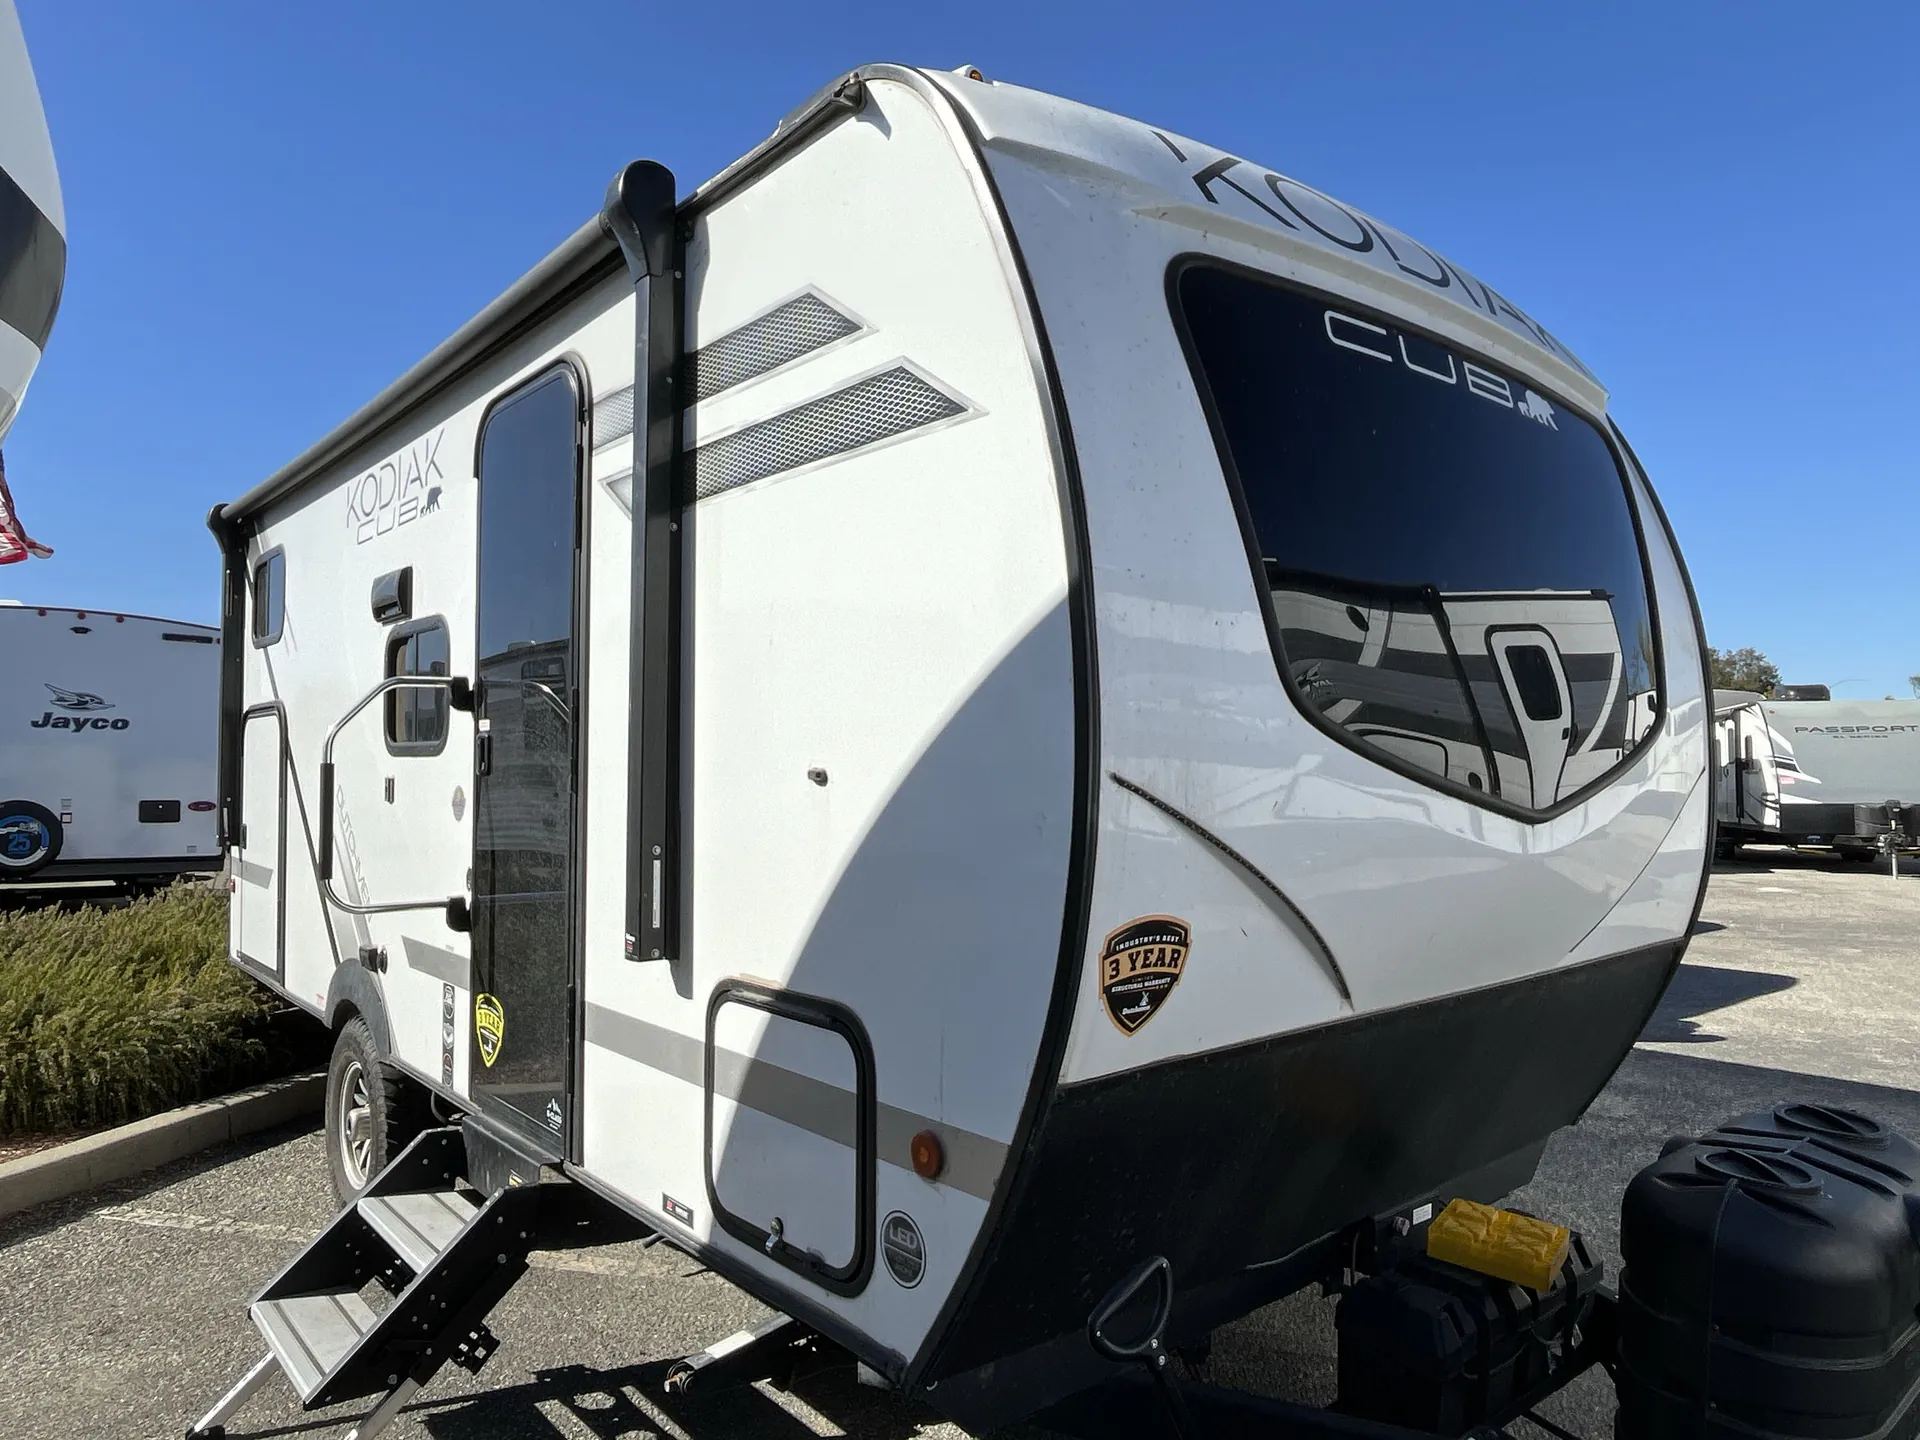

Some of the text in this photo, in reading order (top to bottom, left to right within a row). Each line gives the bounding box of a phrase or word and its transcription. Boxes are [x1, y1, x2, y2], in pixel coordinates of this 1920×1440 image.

[1324, 309, 1514, 409] CUB
[346, 427, 445, 529] KODIAK
[357, 495, 420, 545] CUB
[30, 711, 130, 733] Jayco
[1794, 725, 1919, 734] PASSPORT
[8, 833, 32, 852] 25
[1109, 947, 1181, 980] 3 YEAR
[889, 1222, 918, 1250] LED
